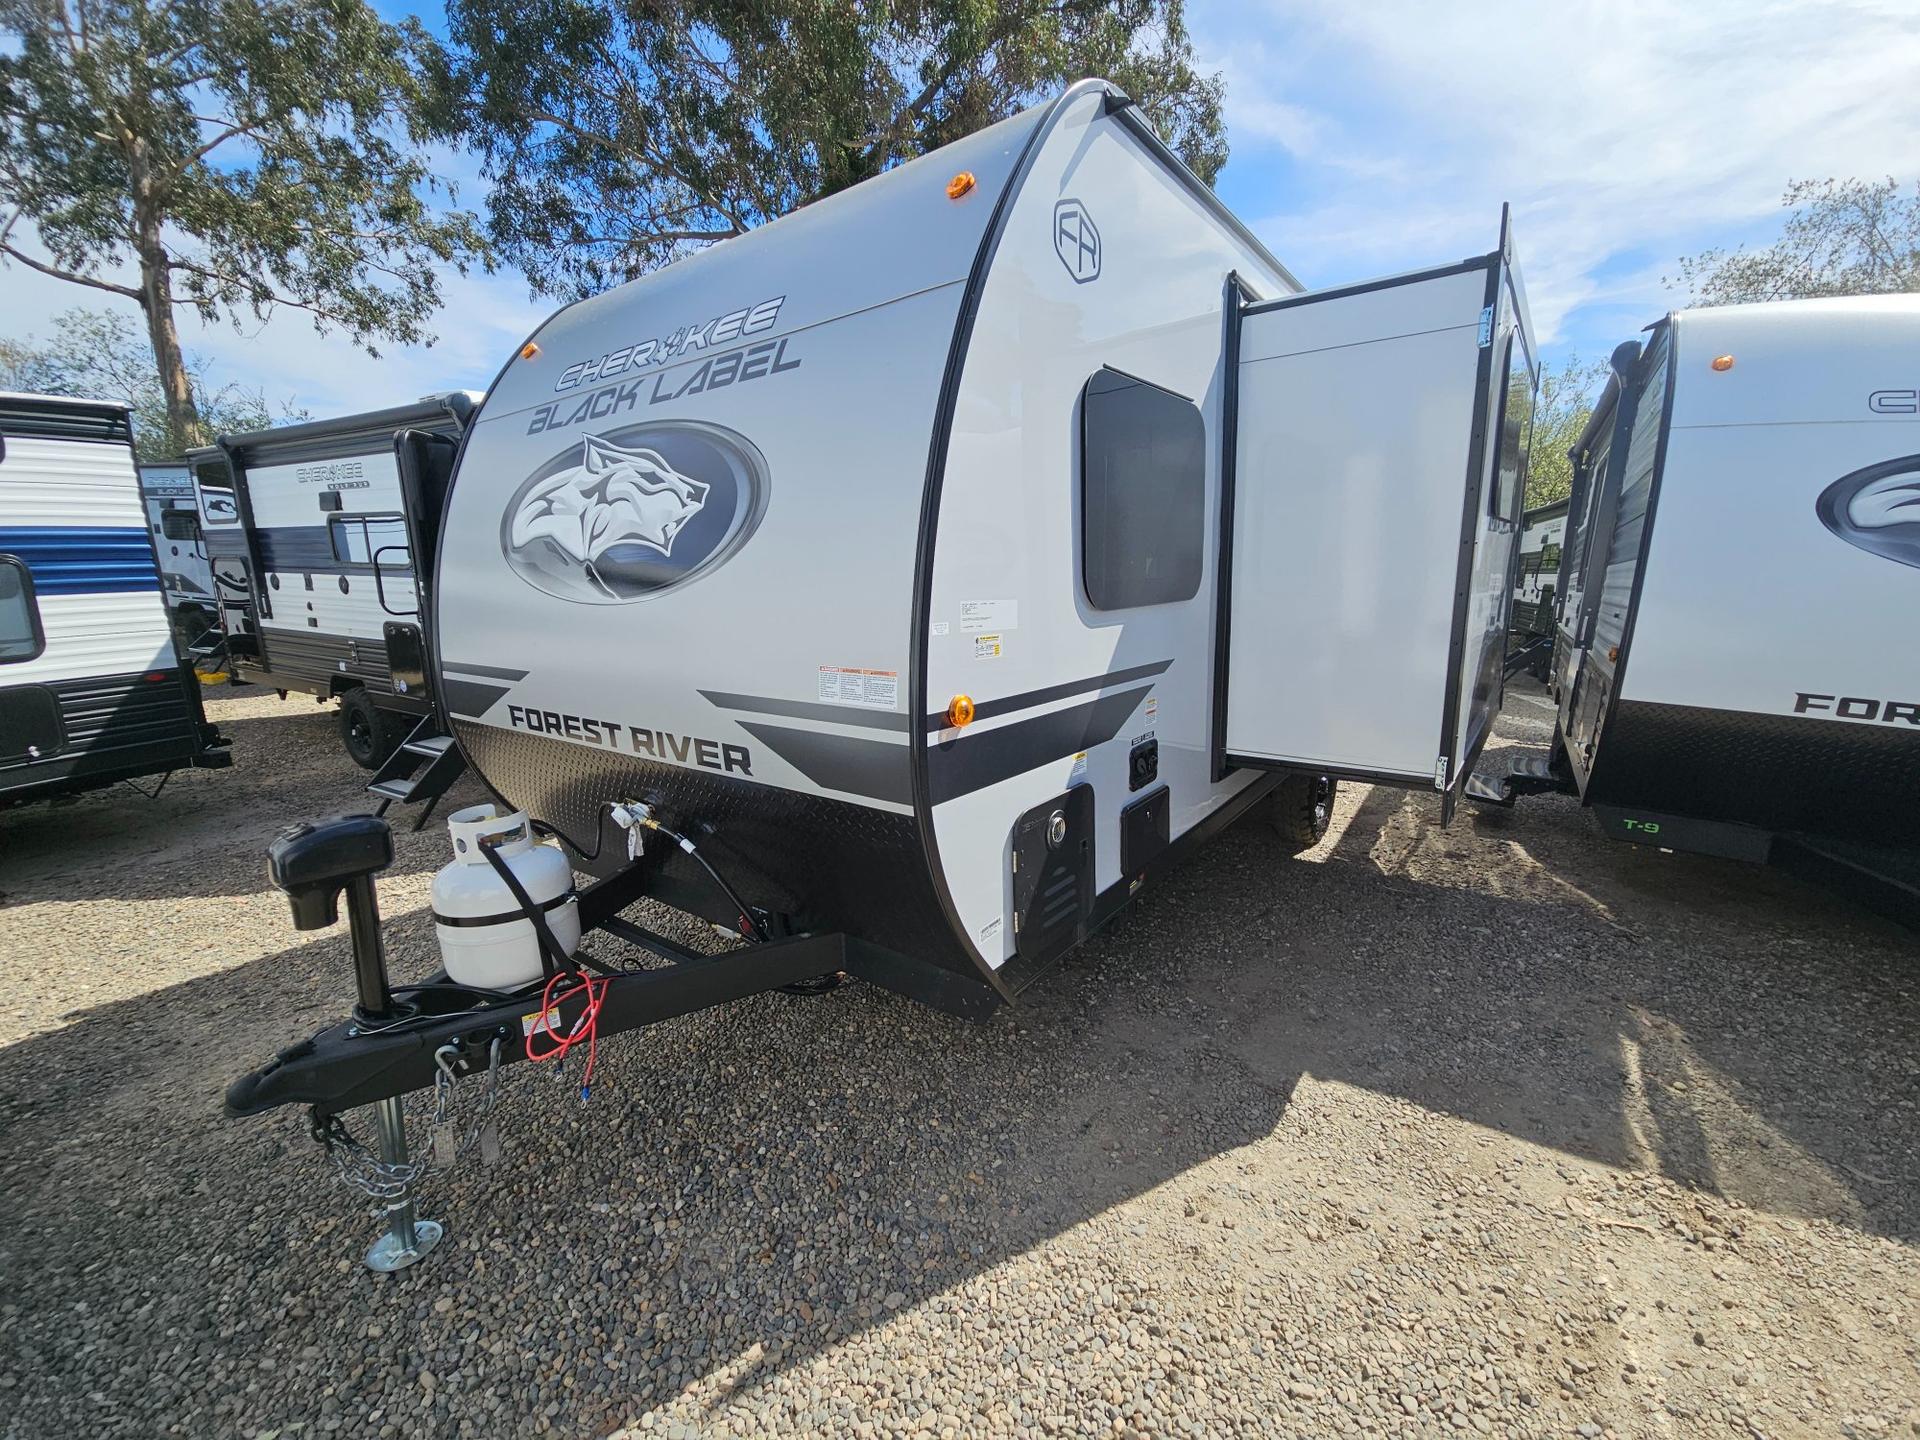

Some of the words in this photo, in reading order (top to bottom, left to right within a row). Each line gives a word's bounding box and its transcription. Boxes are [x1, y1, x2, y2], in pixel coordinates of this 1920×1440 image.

[527, 379, 644, 436] BLACK
[649, 338, 802, 405] LABEL
[507, 704, 622, 748] FOREST
[629, 726, 754, 777] RIVER
[1624, 819, 1660, 834] T-9
